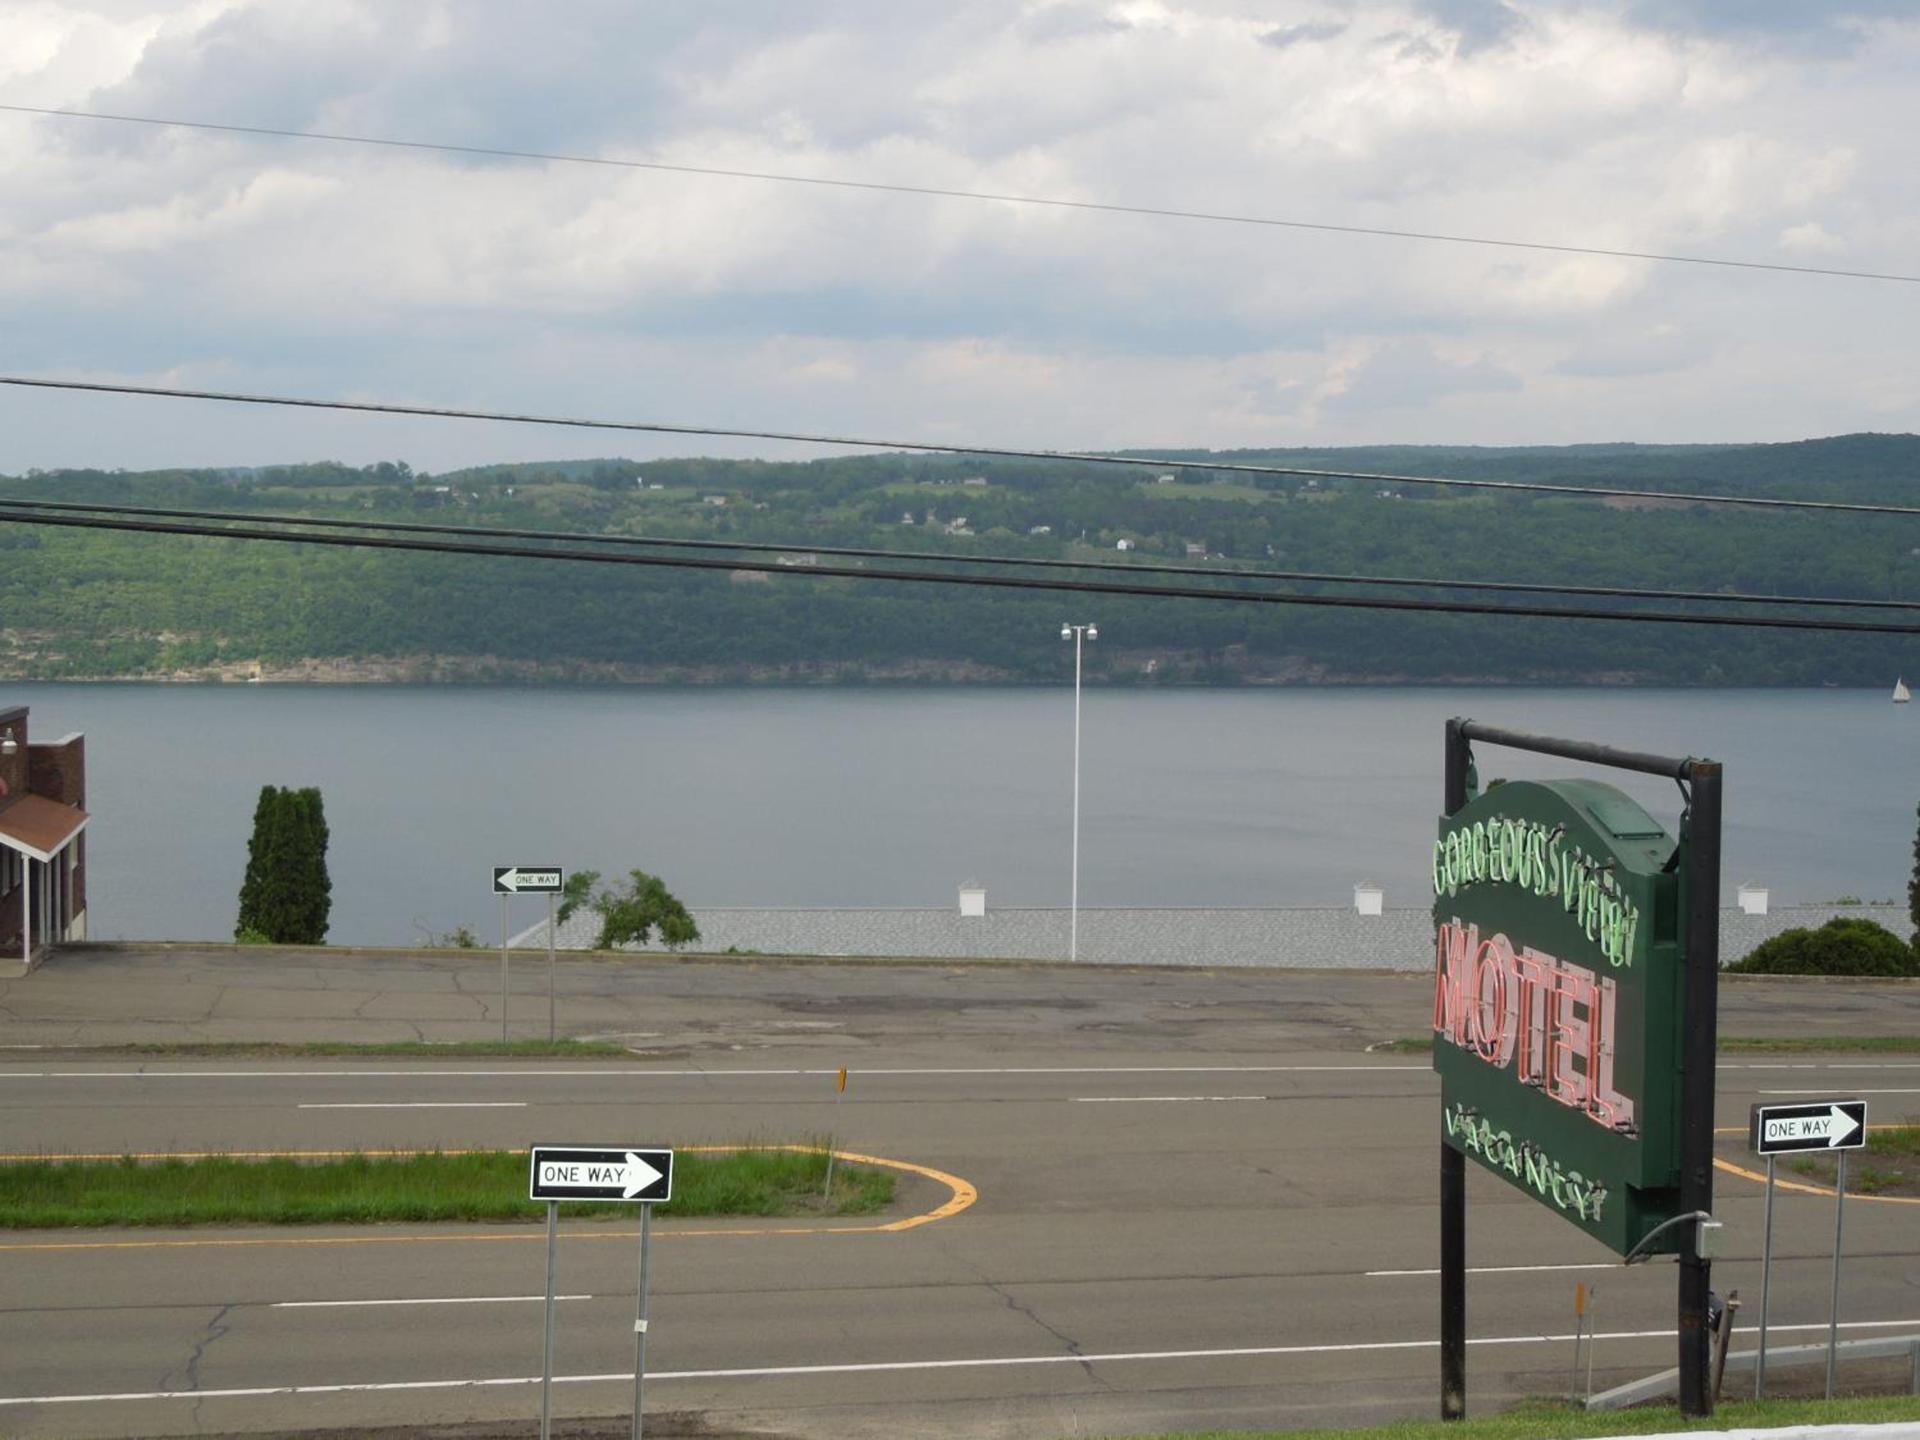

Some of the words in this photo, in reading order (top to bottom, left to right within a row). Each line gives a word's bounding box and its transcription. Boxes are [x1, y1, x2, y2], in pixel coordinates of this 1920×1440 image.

[515, 875, 535, 885] ONE
[537, 875, 557, 885] WAY
[1433, 817, 1563, 898] GORGEOUS
[1434, 915, 1638, 1137] MOTEL
[1769, 1122, 1796, 1137] ONE
[1802, 1119, 1831, 1135] WAY
[544, 1166, 580, 1182] ONE
[587, 1167, 626, 1183] WAY
[1445, 1102, 1608, 1222] VACANCY
